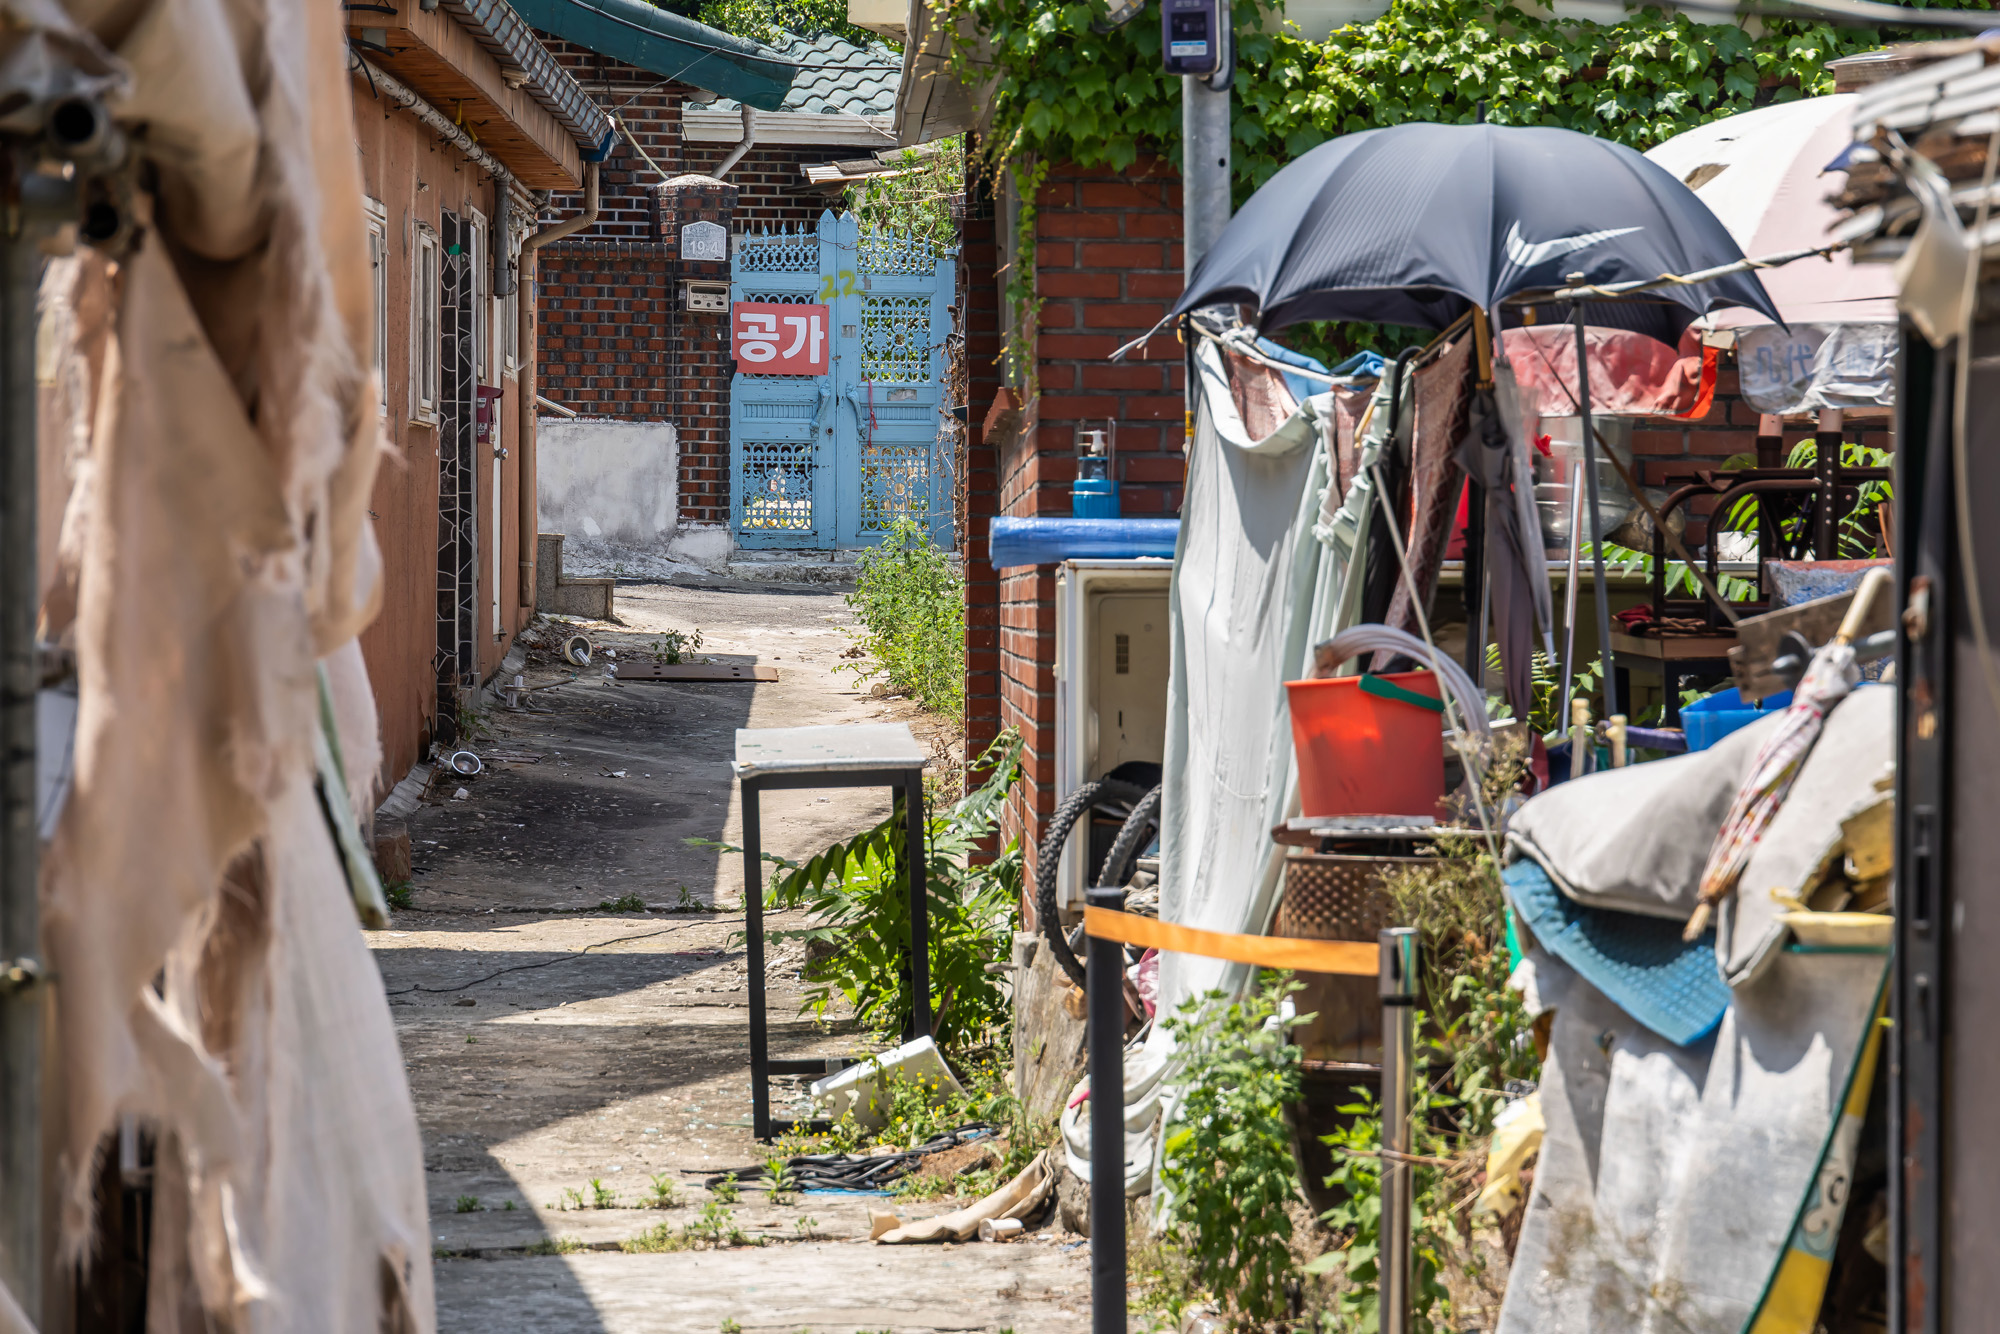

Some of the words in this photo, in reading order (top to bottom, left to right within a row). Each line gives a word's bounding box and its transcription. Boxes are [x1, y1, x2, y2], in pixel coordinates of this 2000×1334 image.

[690, 240, 719, 254] 19-4
[820, 270, 866, 303] 22
[737, 312, 825, 364] 공가
